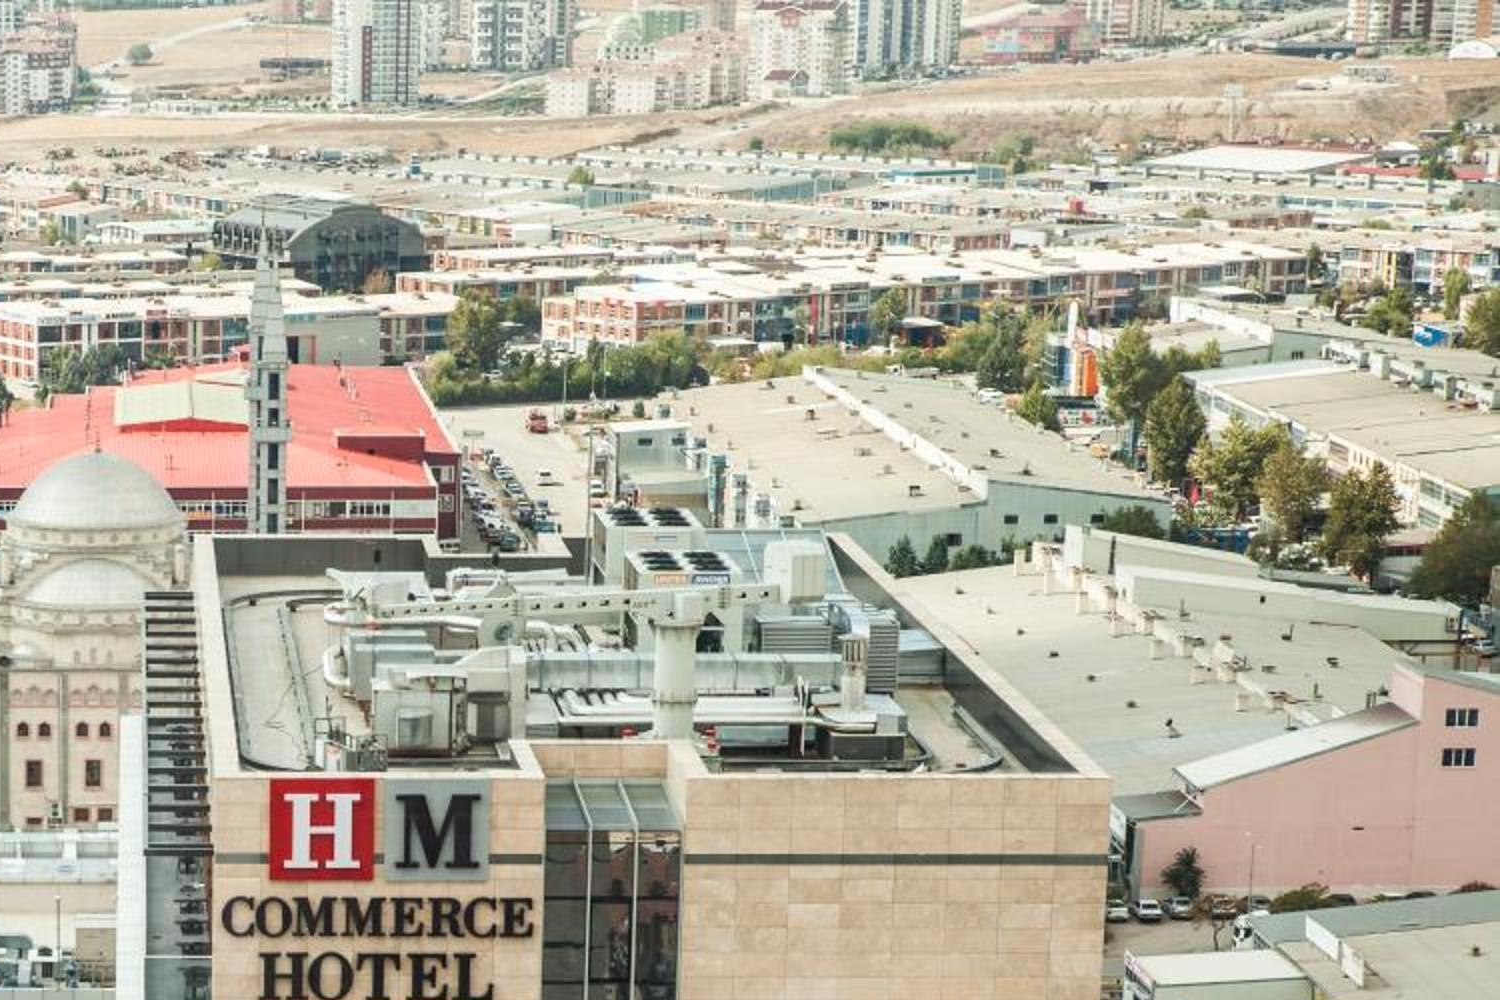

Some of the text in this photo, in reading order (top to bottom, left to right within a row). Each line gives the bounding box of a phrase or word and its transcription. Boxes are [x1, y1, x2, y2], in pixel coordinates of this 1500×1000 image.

[283, 793, 481, 869] H M
[221, 896, 534, 938] COMMERCE
